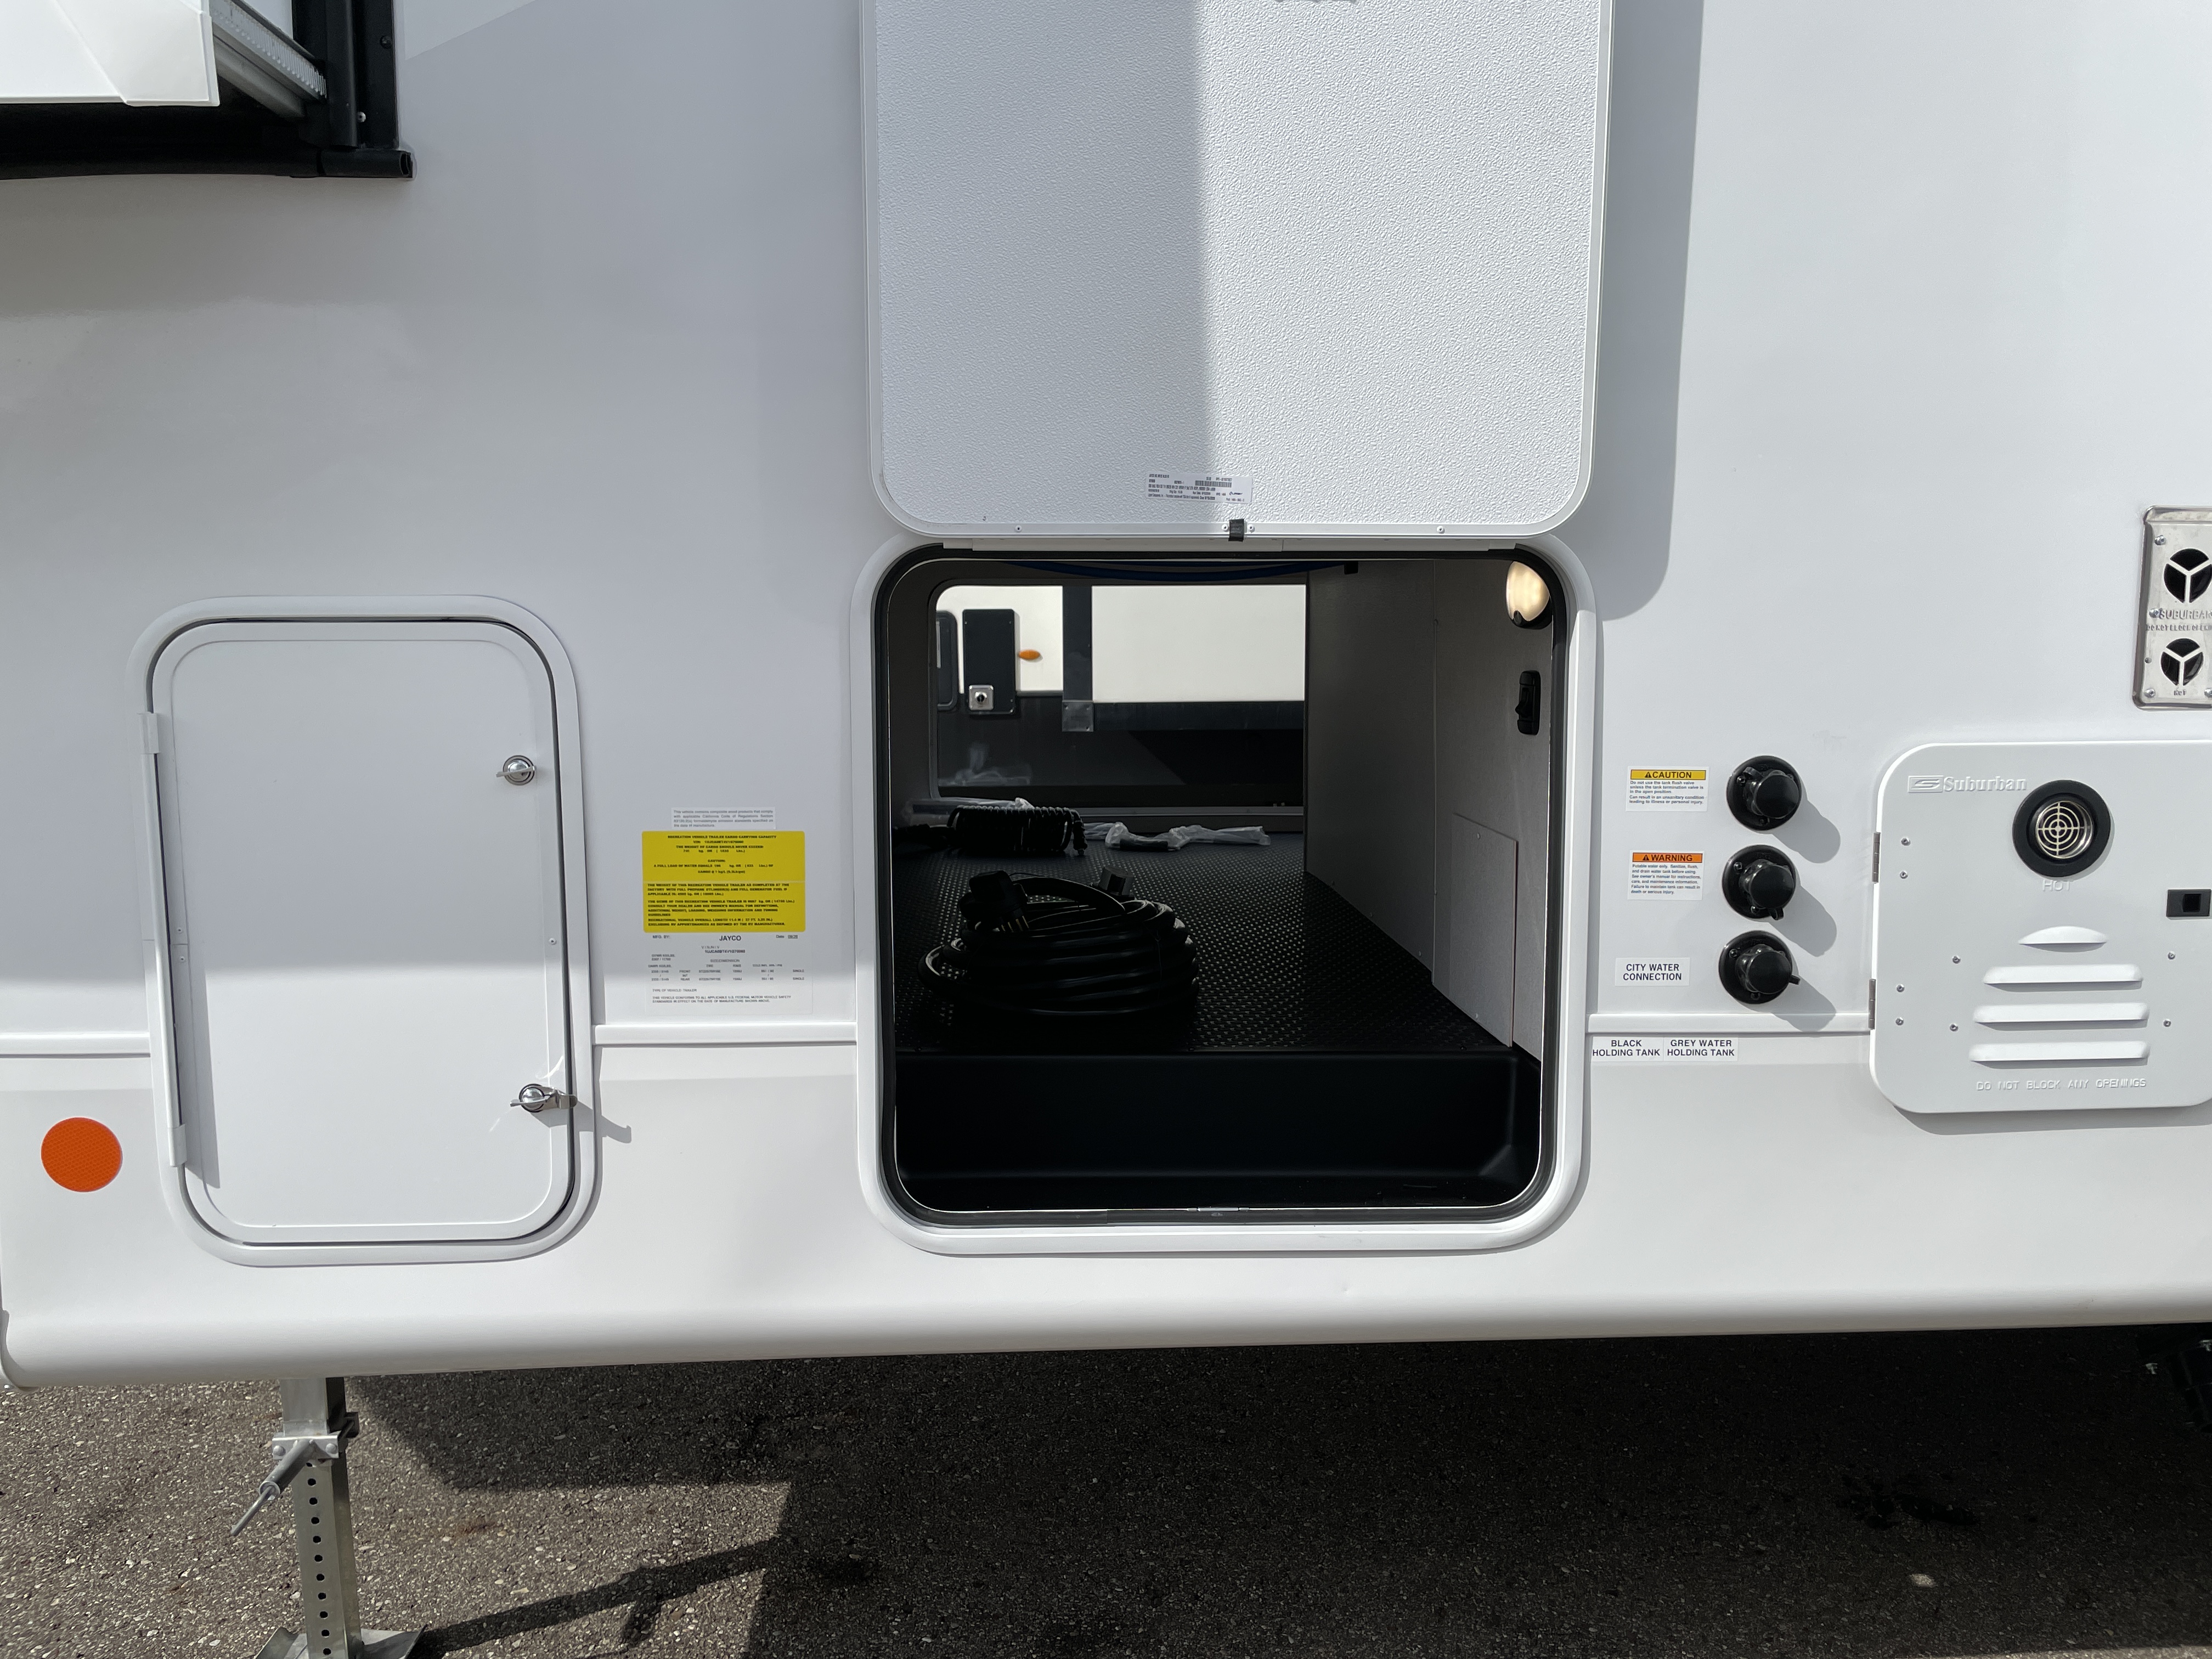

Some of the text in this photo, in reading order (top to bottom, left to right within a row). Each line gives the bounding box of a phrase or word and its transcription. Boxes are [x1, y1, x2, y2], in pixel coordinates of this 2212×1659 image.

[1943, 777, 2028, 792] Suburban
[2042, 880, 2072, 891] HOT
[1622, 973, 1683, 981] CONNECTION
[1976, 1078, 2147, 1091] DO NOT BLOCK ANY OPENINGS
